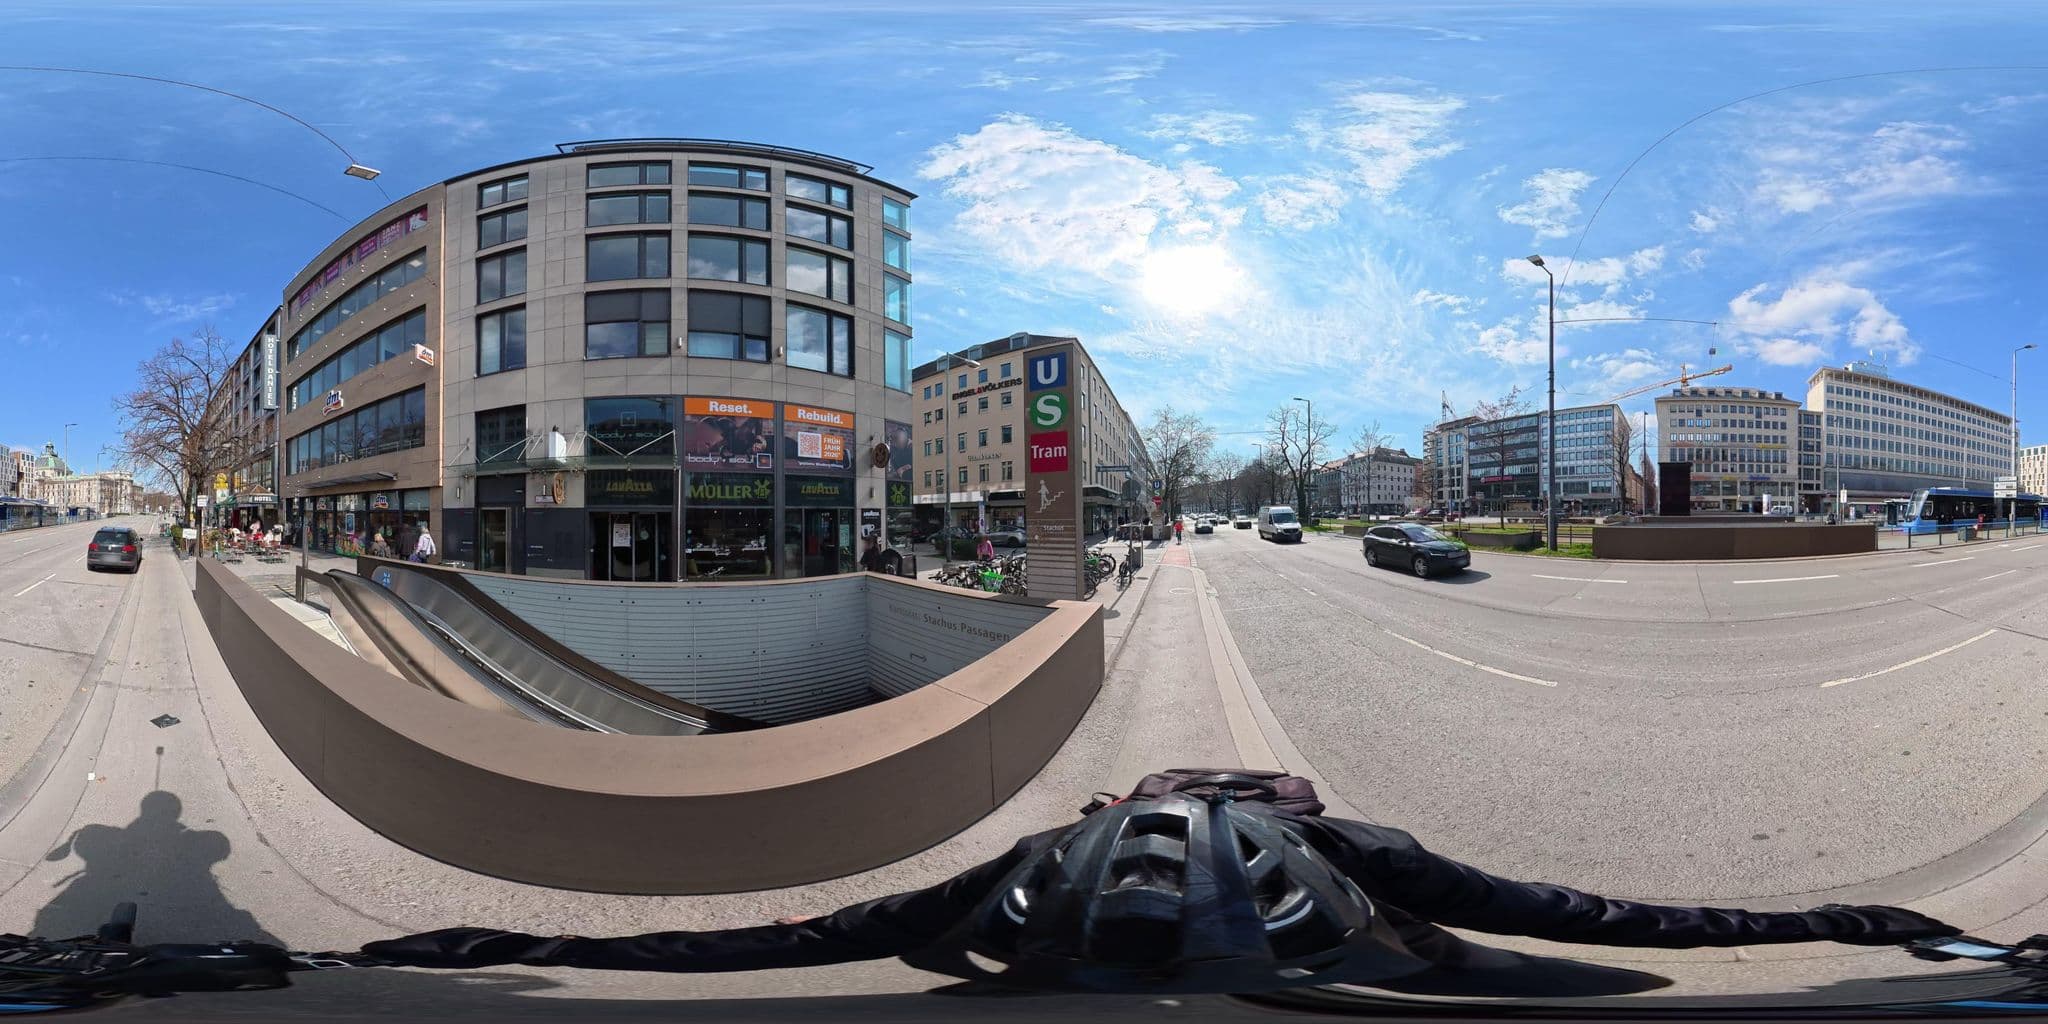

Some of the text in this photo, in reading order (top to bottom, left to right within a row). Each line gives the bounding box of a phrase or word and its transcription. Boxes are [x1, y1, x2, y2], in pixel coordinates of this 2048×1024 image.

[1036, 358, 1060, 385] U
[709, 401, 753, 414] Reset.
[1036, 395, 1062, 426] S
[797, 408, 844, 425] Rebuild.
[688, 453, 754, 465] body soul
[1031, 445, 1067, 459] Tram
[606, 479, 655, 492] LAVAZZA
[801, 482, 840, 495] LAVAZZA
[923, 613, 1011, 642] Stachus Passagen
